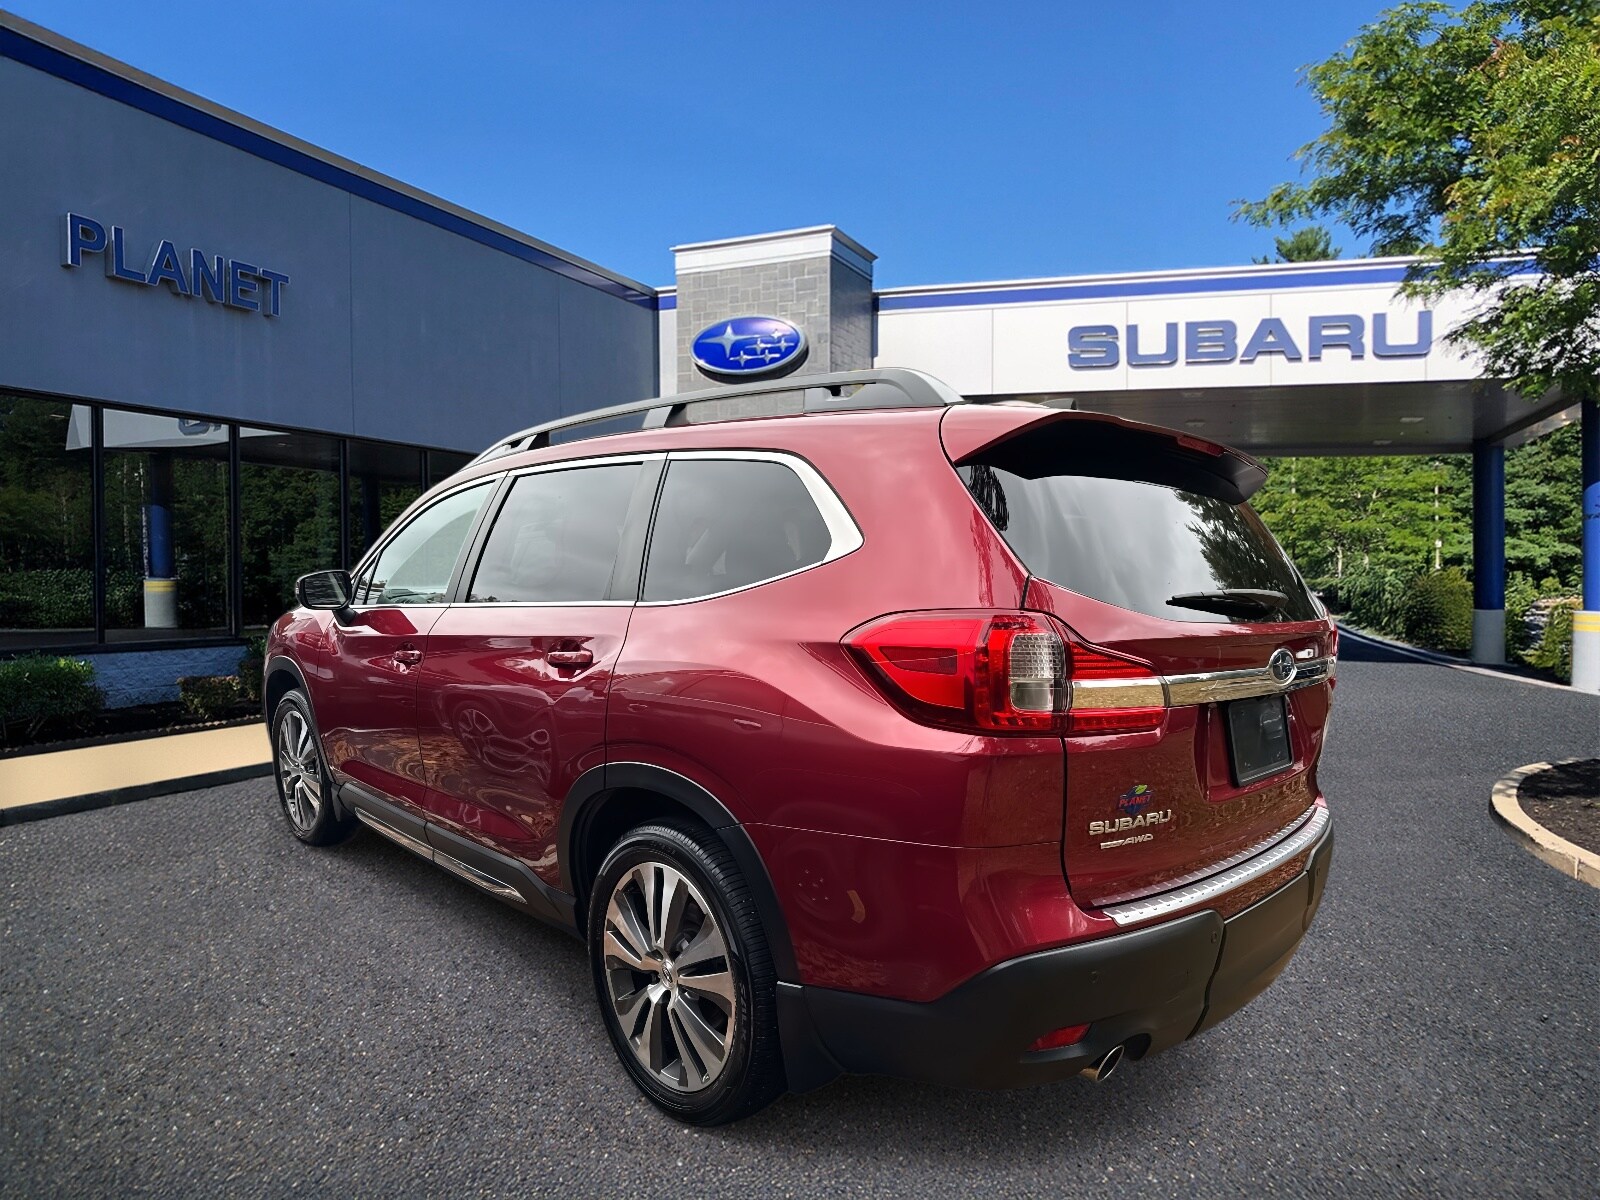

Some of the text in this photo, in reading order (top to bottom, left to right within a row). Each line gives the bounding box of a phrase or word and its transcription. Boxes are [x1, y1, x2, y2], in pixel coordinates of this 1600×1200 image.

[64, 212, 289, 317] PLANET
[1068, 310, 1433, 369] SUBARU
[1118, 794, 1152, 808] PLANET
[1088, 809, 1172, 836] SUBARU
[1122, 833, 1154, 846] AWD
